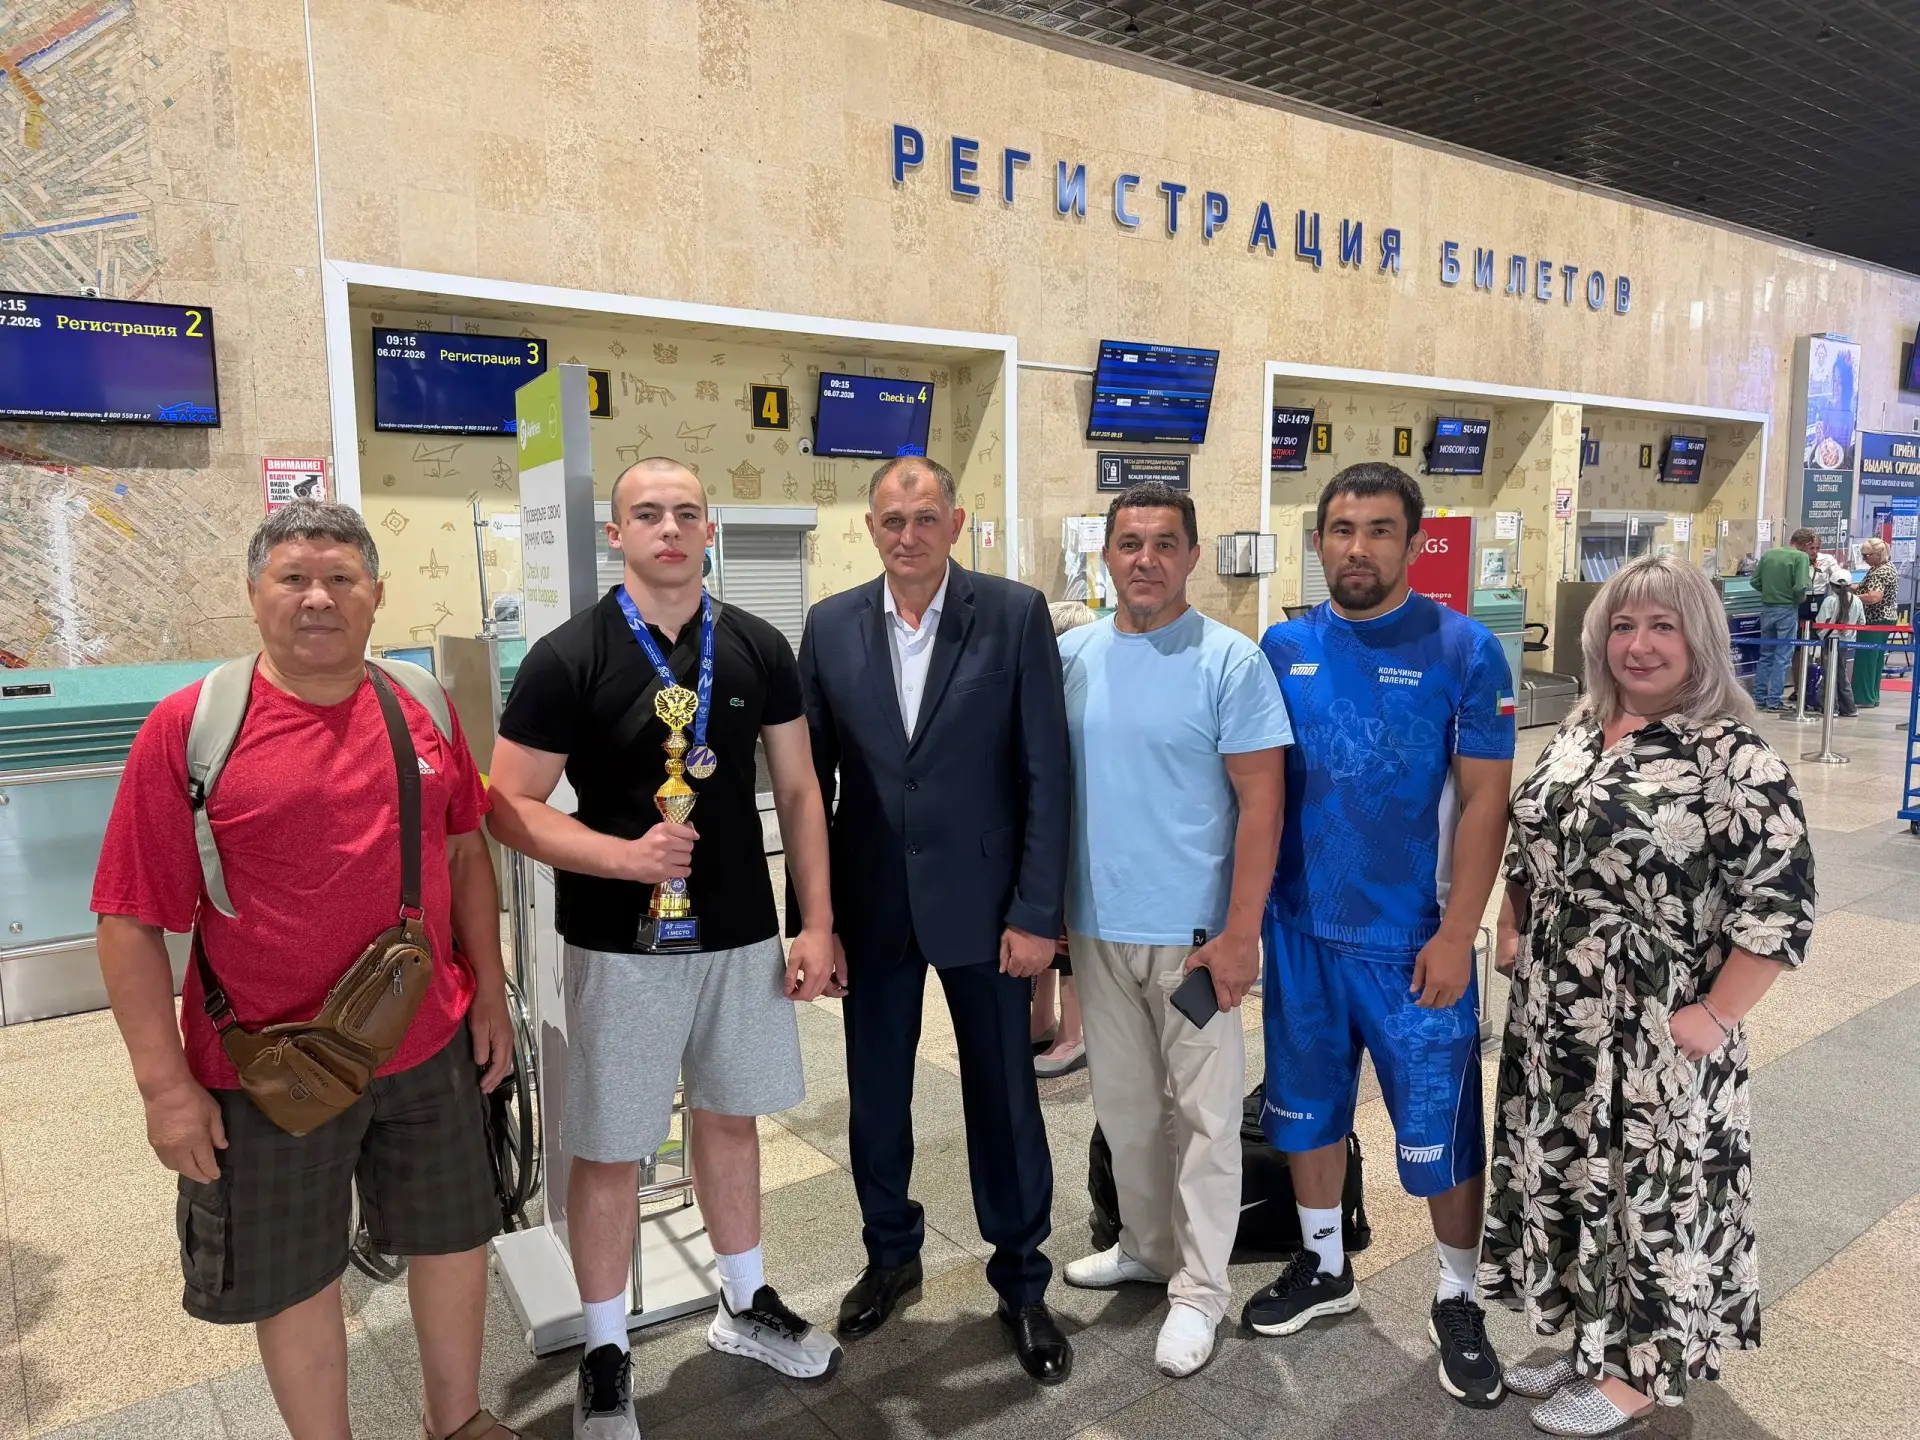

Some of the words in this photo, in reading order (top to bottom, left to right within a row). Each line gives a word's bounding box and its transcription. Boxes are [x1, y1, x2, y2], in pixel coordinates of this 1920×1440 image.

[892, 123, 1401, 273] РЕГИСТРАЦИЯ
[1441, 240, 1632, 314] БИЛЕТОВ
[56, 315, 177, 337] Регистрация
[185, 310, 204, 337] 2
[386, 335, 417, 346] 09:15
[377, 348, 425, 359] 06.07.2026
[440, 350, 521, 366] Регистрация
[527, 342, 539, 364] 3
[830, 380, 850, 389] 09:15
[824, 390, 855, 399] 06.07.2026
[879, 392, 905, 403] Check
[906, 394, 915, 403] in
[918, 386, 927, 404] 4
[762, 391, 779, 424] 4
[158, 412, 217, 423] АБАКАН
[1278, 413, 1310, 424] SU-1479
[1463, 424, 1486, 434] SU-1479
[1283, 436, 1298, 445] SVO
[1317, 426, 1327, 450] 5
[1398, 431, 1408, 454] 6
[1439, 445, 1464, 454] MOSCOW
[1590, 443, 1596, 463] 7
[1642, 447, 1649, 466] 8
[1893, 441, 1916, 458] ПРИЁМ
[1863, 459, 1893, 474] ВЫДАЧА
[1895, 461, 1920, 476] ОРУЖИ
[523, 506, 547, 526] Проверьте
[547, 504, 561, 519] свою
[525, 531, 540, 550] ручную
[540, 530, 555, 546] кладь
[1421, 538, 1449, 554] GS
[526, 561, 540, 579] Check
[540, 565, 550, 584] your
[527, 585, 538, 602] hand
[538, 586, 558, 608] baggage
[1421, 591, 1452, 600] мфорта
[1378, 666, 1423, 679] КОЛЬЧИКОВ
[1267, 1101, 1304, 1120] ЛЬЧИКОВ
[1306, 1112, 1315, 1120] В.
[1318, 1225, 1336, 1235] NIKE
